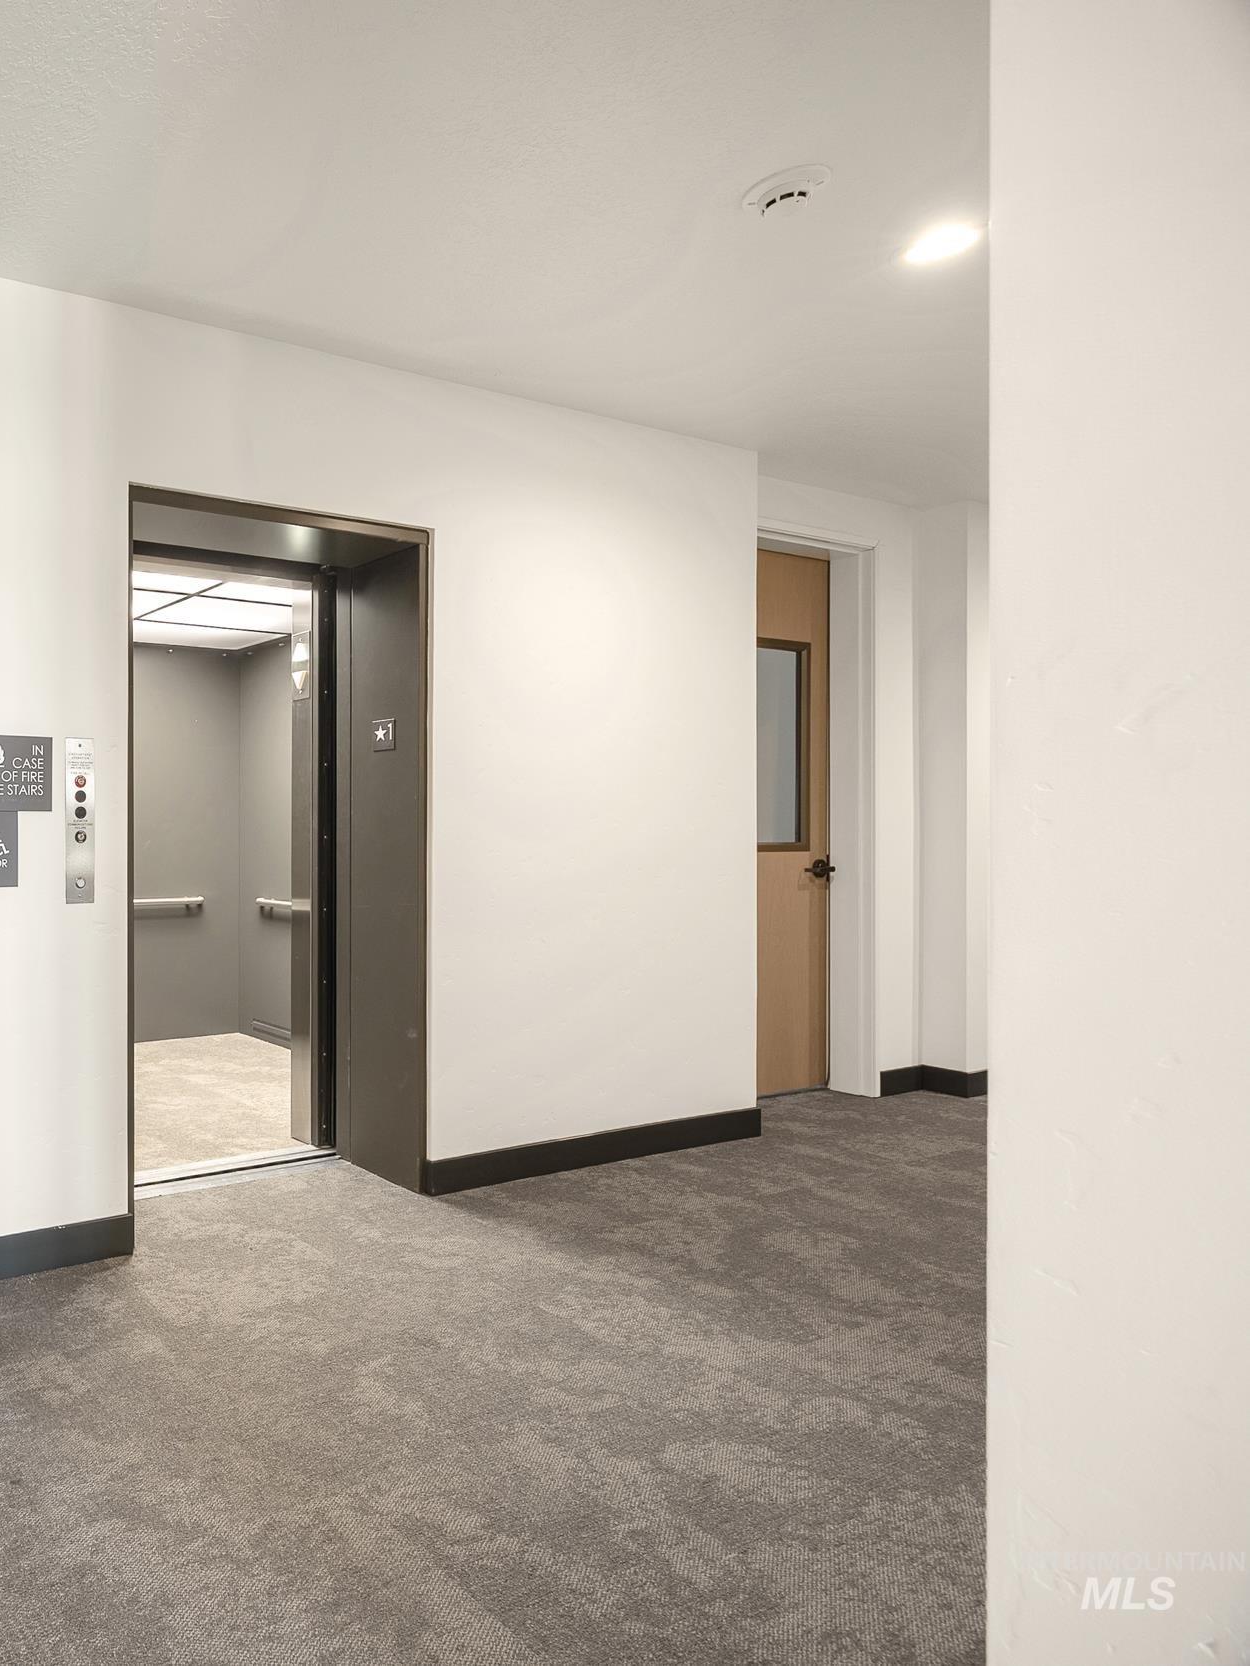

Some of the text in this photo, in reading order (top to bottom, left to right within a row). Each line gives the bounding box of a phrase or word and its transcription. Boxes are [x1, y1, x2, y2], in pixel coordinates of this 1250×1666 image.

[387, 722, 393, 740] 1
[32, 744, 44, 756] IN
[12, 757, 44, 770] CASE
[1, 771, 44, 783] OF FIRE
[7, 784, 44, 796] STAIRS
